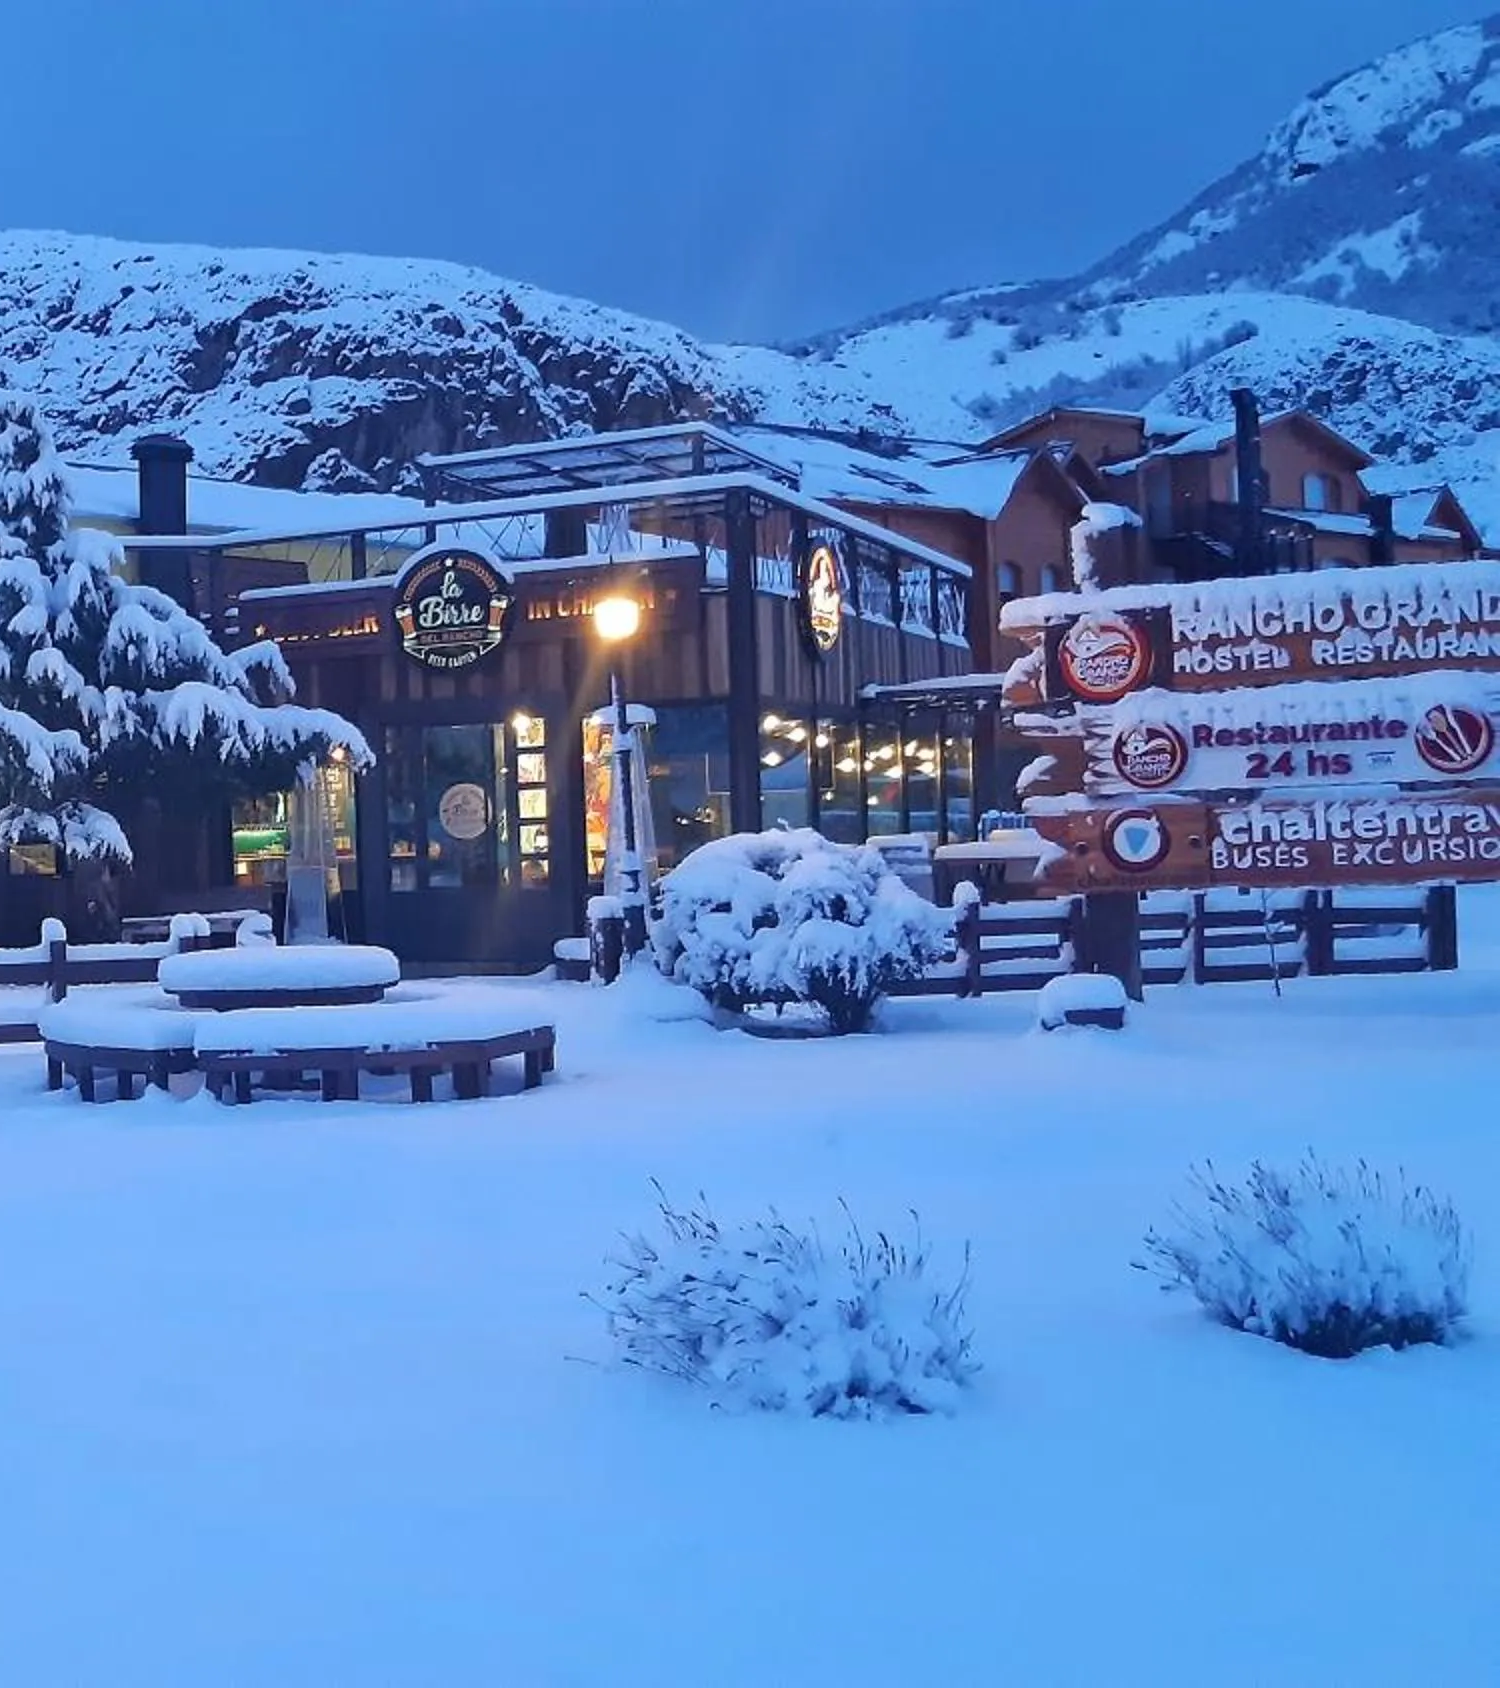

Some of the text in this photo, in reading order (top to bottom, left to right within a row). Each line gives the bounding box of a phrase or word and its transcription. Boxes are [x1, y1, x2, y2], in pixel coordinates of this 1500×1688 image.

[441, 571, 464, 599] la
[418, 595, 484, 628] Birre
[1171, 594, 1343, 643] RANCHO
[1173, 642, 1291, 674] HOSTEL
[1191, 714, 1409, 749] Restaurante
[1245, 750, 1296, 779] 24
[1306, 749, 1353, 777] hs
[1211, 839, 1309, 870] BUSES
